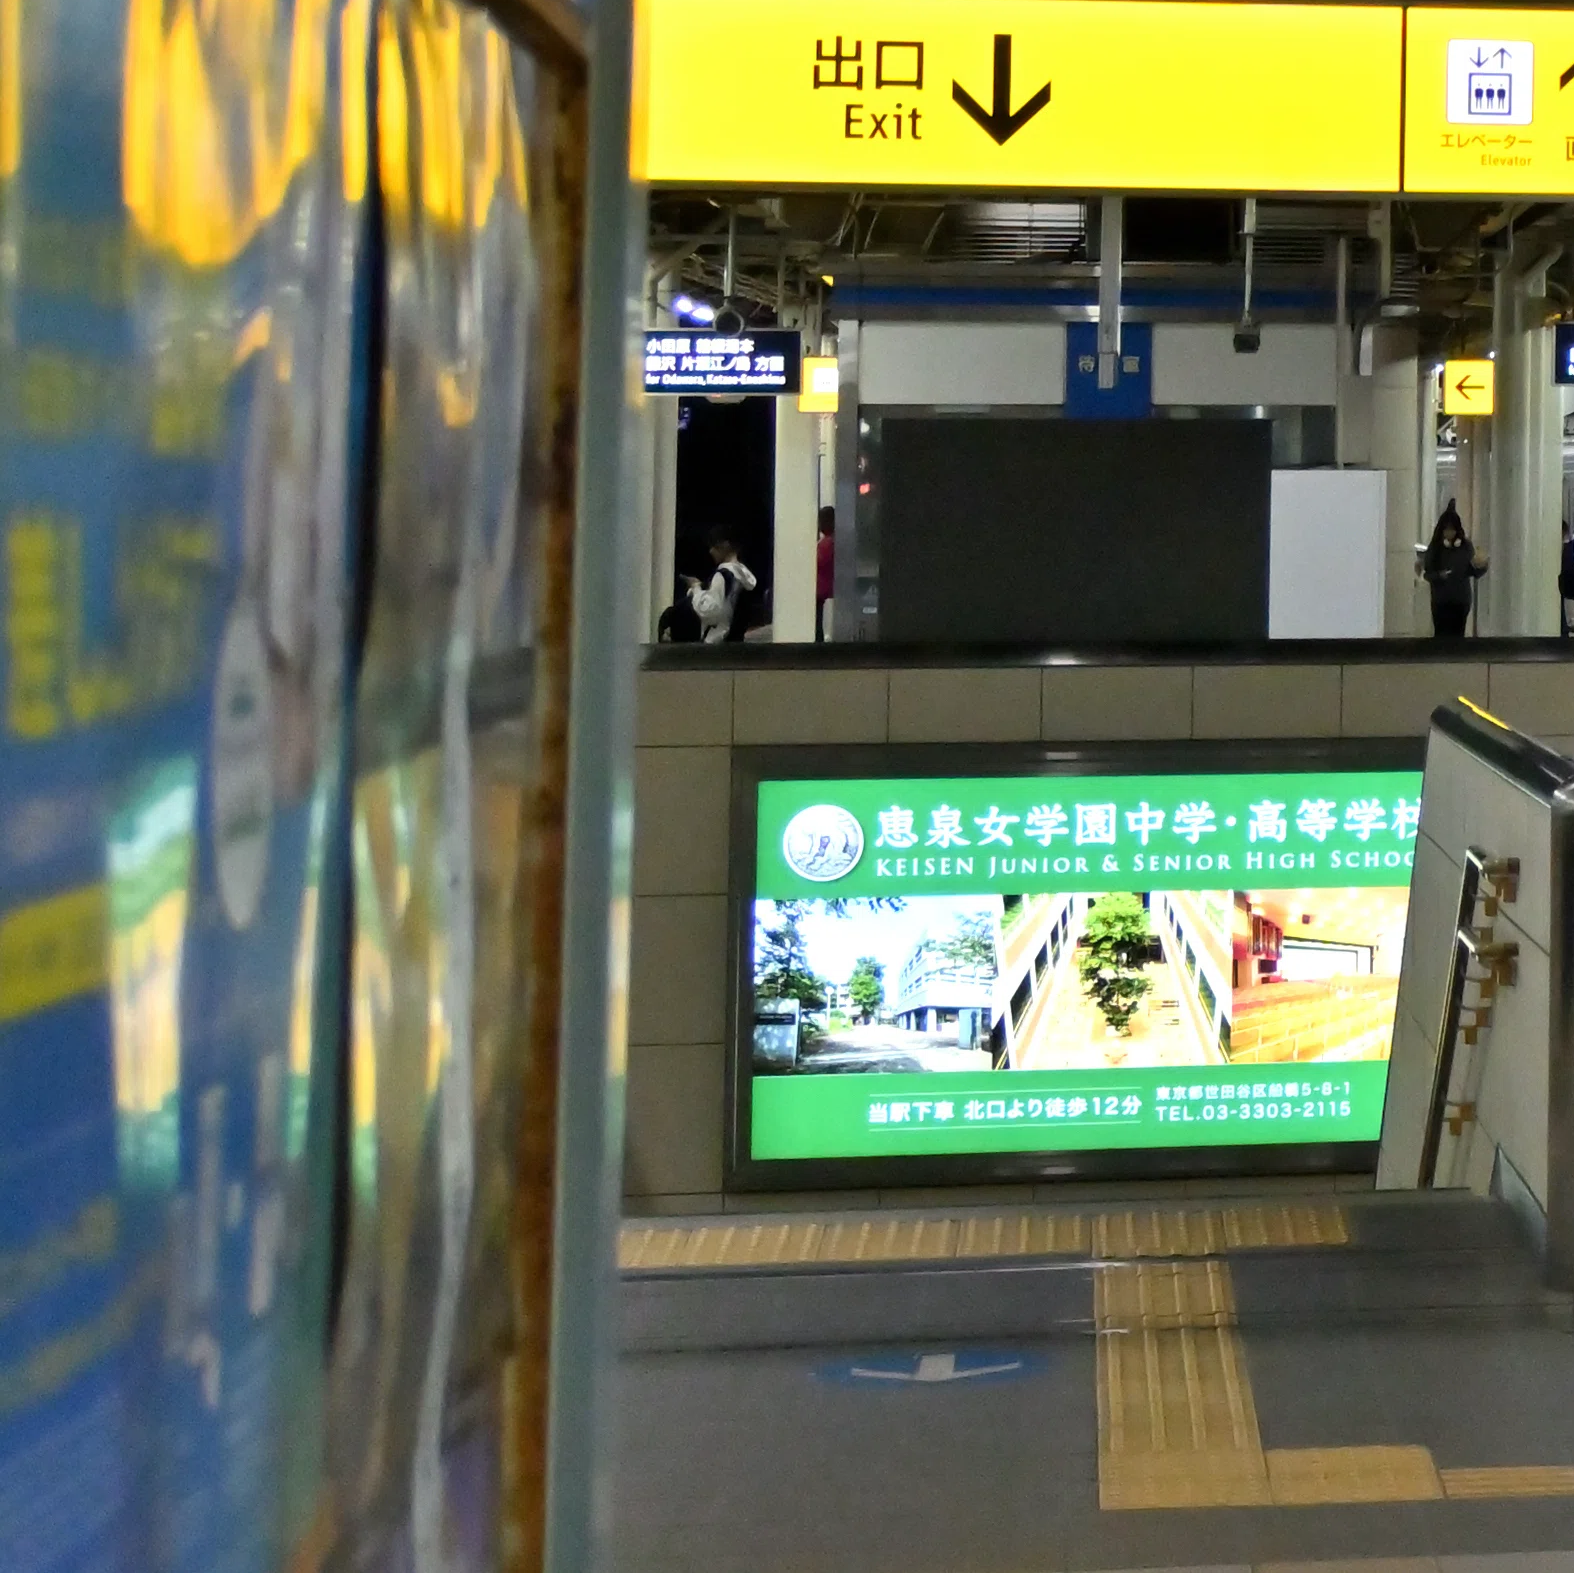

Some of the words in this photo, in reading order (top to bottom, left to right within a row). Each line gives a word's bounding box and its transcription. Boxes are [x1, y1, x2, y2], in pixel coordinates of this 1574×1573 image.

[812, 36, 925, 91] 出口
[844, 103, 923, 141] Exit
[1439, 131, 1534, 152] エレベーター
[1479, 153, 1533, 168] Elevator
[876, 856, 974, 878] KEISEN
[987, 855, 1089, 879] JUNIOR
[1101, 853, 1121, 873] &
[1133, 852, 1233, 872] SENIOR
[1246, 850, 1316, 871] HIGH
[868, 1101, 954, 1124] 当駅下車
[963, 1095, 1144, 1121] 北口より徒歩12分
[1155, 1101, 1352, 1123] TEL.03-3303-2115
